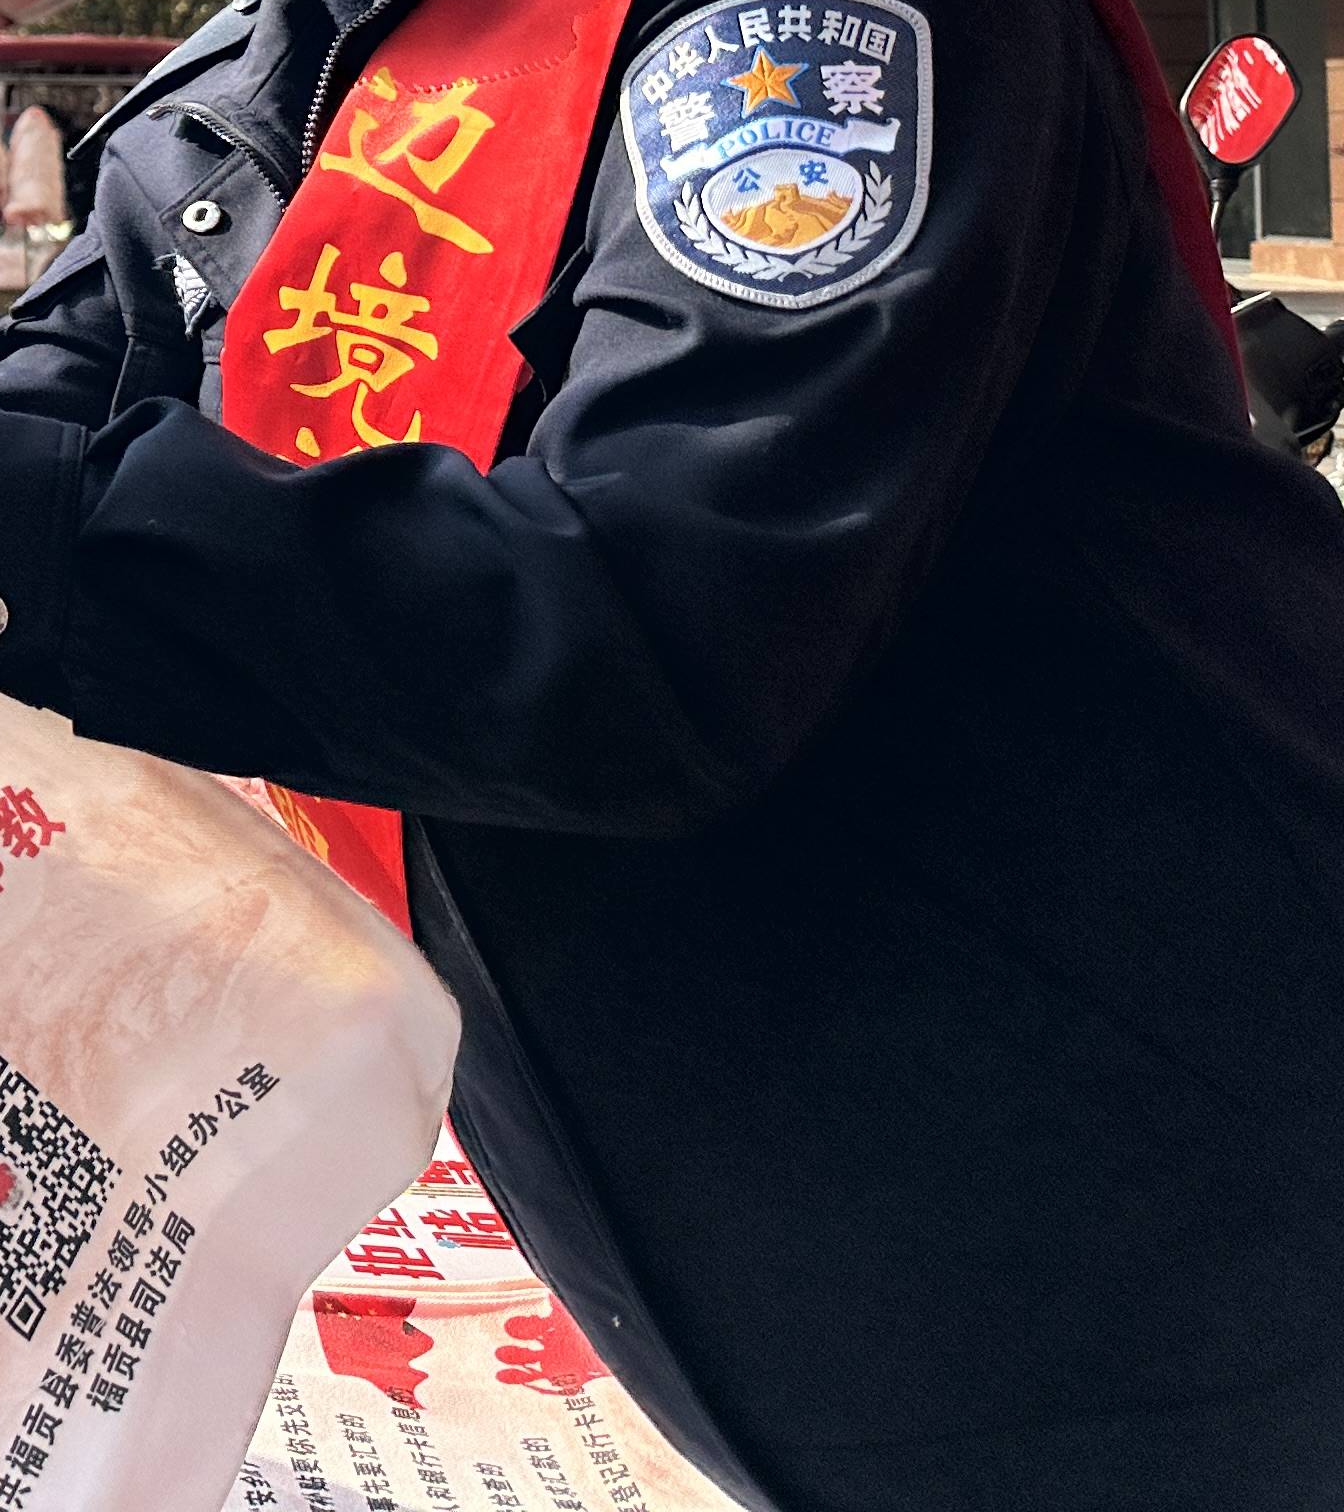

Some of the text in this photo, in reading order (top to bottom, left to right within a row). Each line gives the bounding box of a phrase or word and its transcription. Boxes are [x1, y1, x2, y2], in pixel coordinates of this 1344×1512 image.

[641, 4, 897, 105] 中华人民共和国
[717, 120, 838, 161] POLICE
[263, 67, 496, 466] 边境
[86, 1210, 196, 1413] 福贡县司法局
